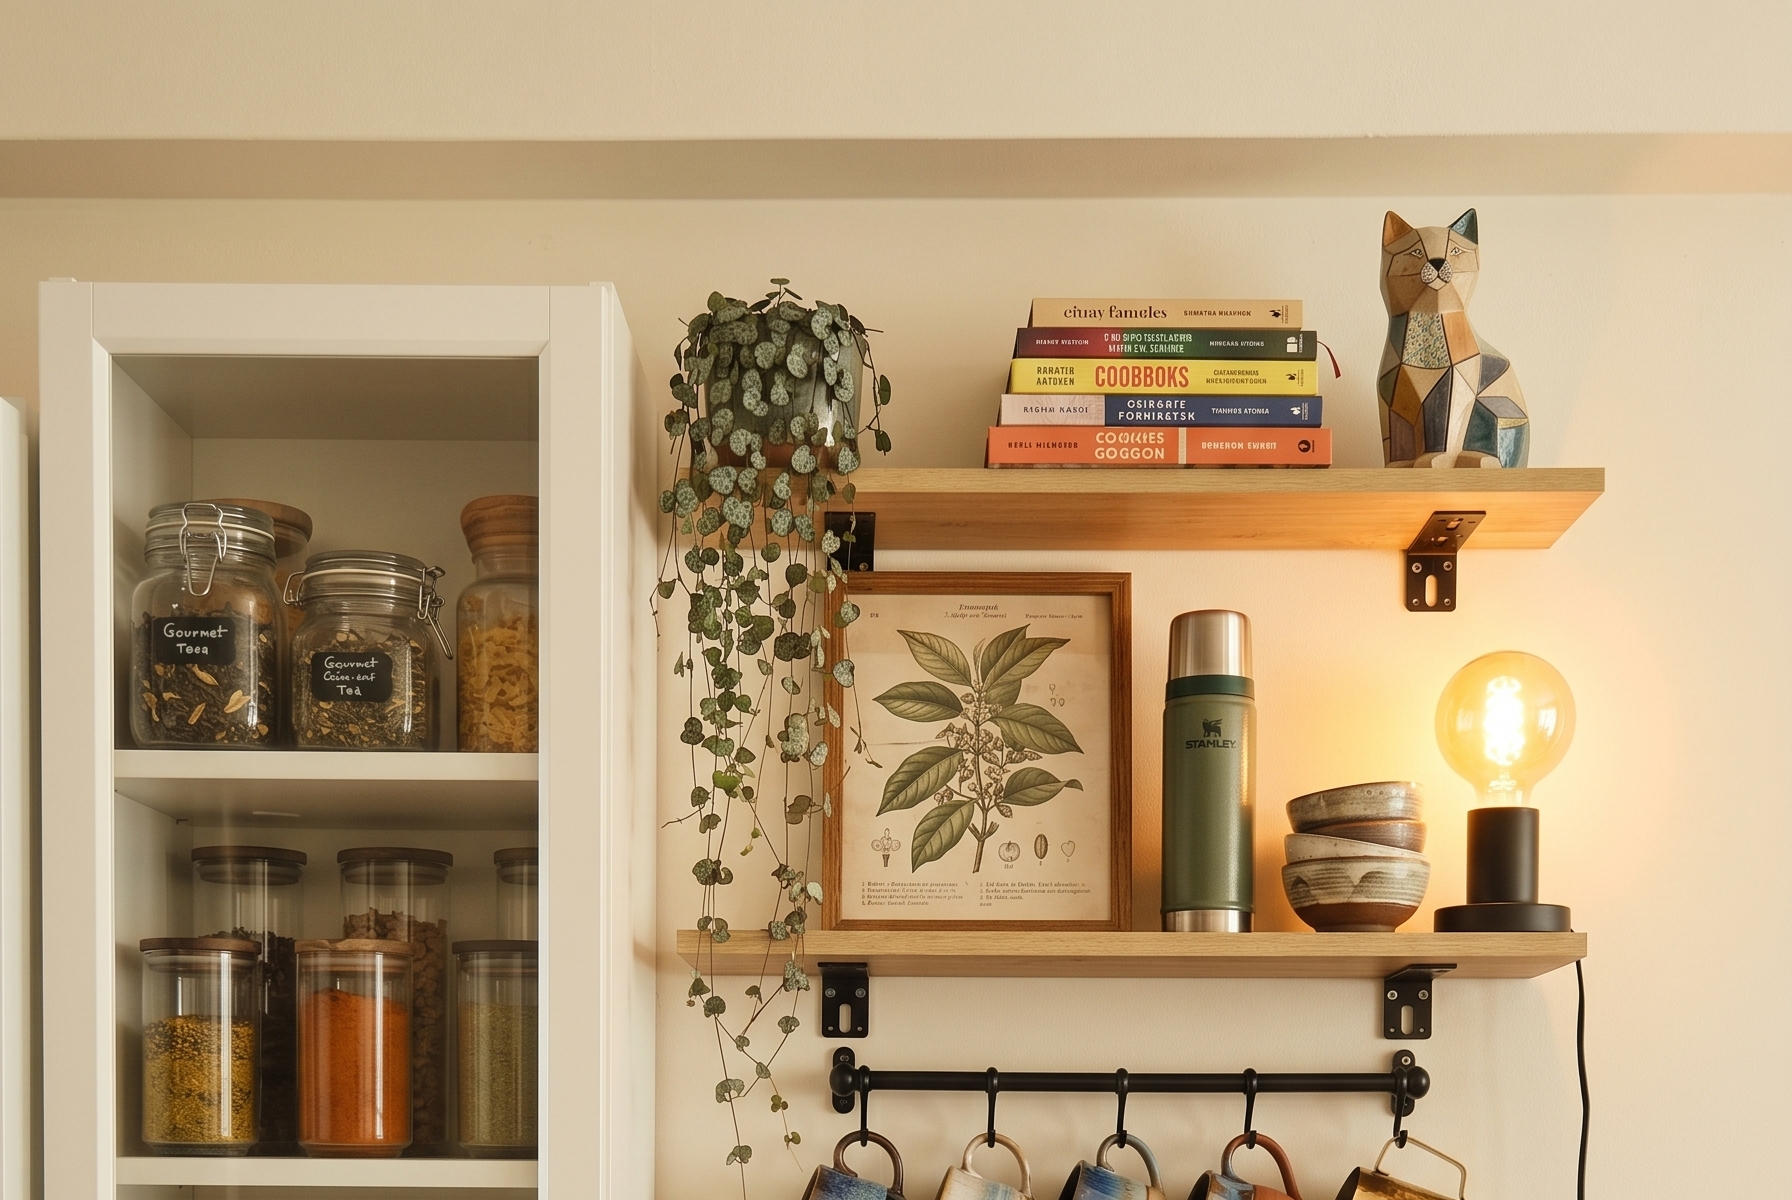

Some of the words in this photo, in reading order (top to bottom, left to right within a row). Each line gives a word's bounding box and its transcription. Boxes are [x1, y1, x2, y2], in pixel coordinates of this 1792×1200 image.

[1094, 365, 1190, 389] COOBBOKS
[163, 622, 229, 638] Gourmet
[336, 685, 362, 696] Tea
